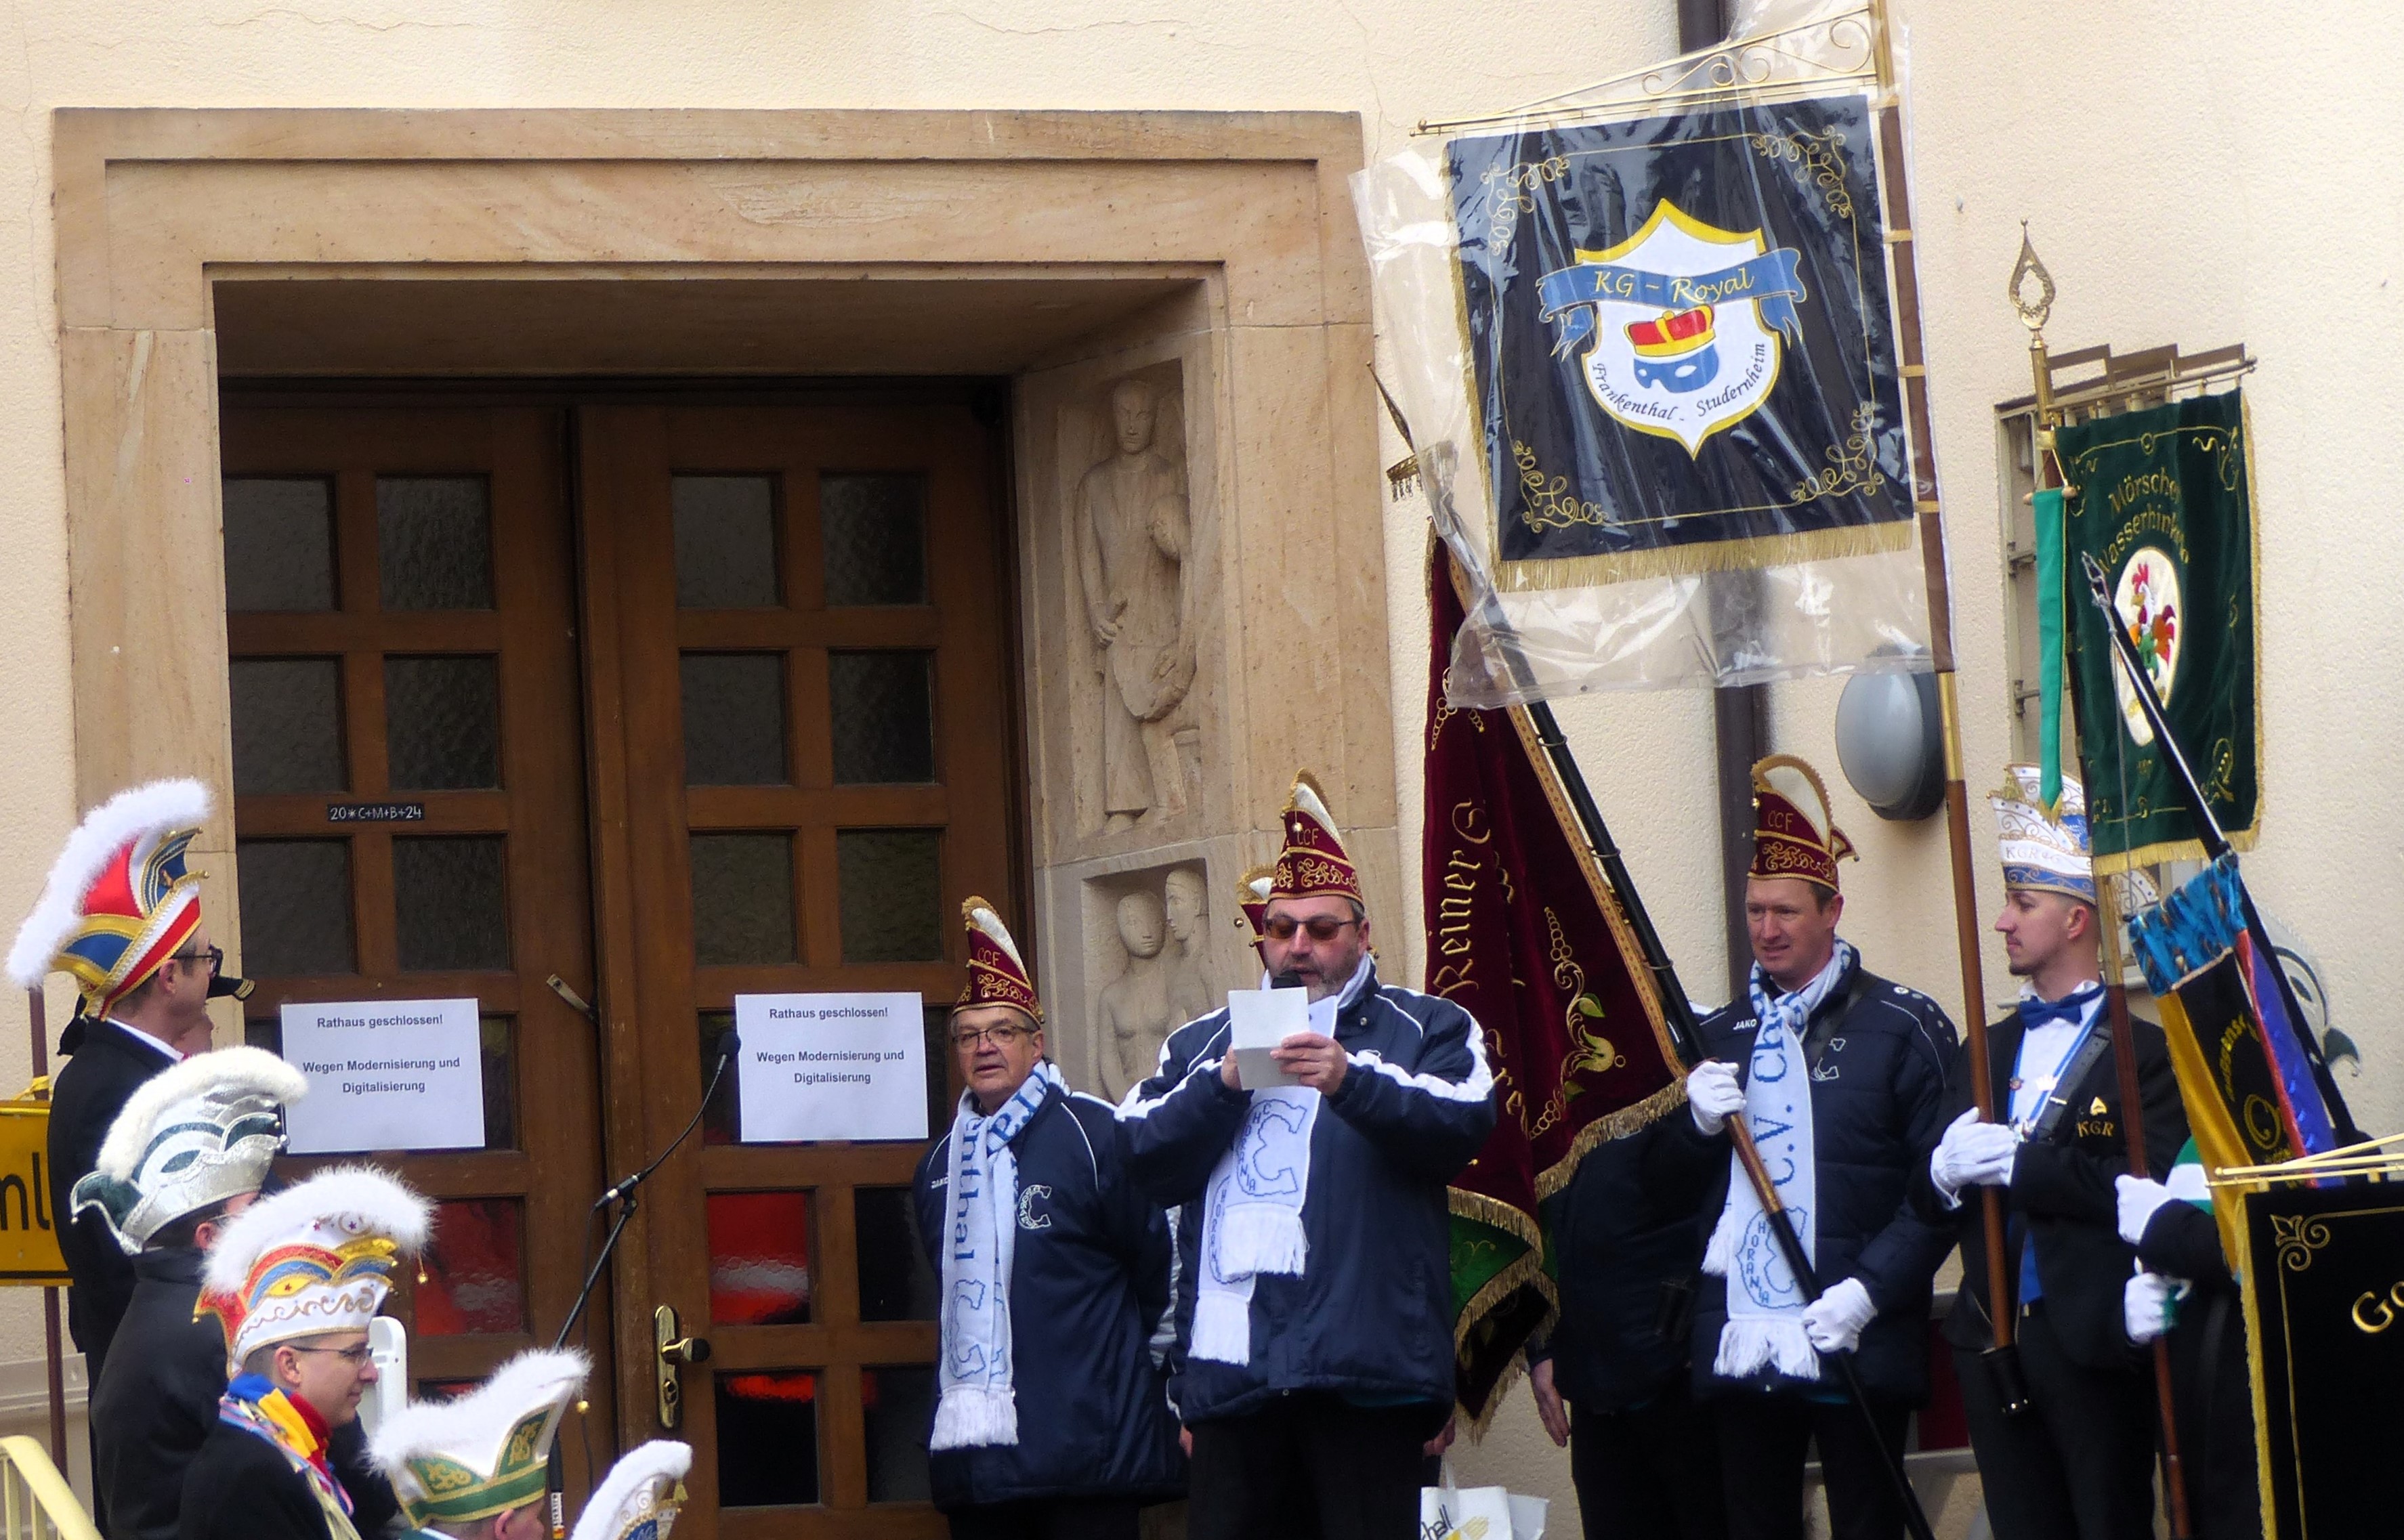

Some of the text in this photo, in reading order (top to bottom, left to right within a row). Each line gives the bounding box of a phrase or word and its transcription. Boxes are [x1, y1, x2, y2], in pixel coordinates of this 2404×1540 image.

[1594, 271, 1635, 297] KG
[1670, 267, 1754, 303] Royal
[1592, 363, 1679, 421] Frankenthal
[1695, 343, 1765, 417] Studernheim
[1767, 810, 1794, 832] CCF
[1428, 849, 1482, 999] Reiner
[977, 947, 1001, 966] CCF
[317, 1014, 443, 1029] Rathaus geschlossen!
[769, 1007, 888, 1020] Rathaus geschlossen!
[1733, 1019, 1757, 1030] JAKO
[303, 1057, 461, 1074] Wegen Modernisierung und
[757, 1050, 905, 1064] Wegen Modernisierung und
[794, 1072, 871, 1086] Digitalisierung
[342, 1082, 425, 1096] Digitalisierung
[2076, 1119, 2115, 1138] KGR
[1746, 1221, 1770, 1304] HORANIA
